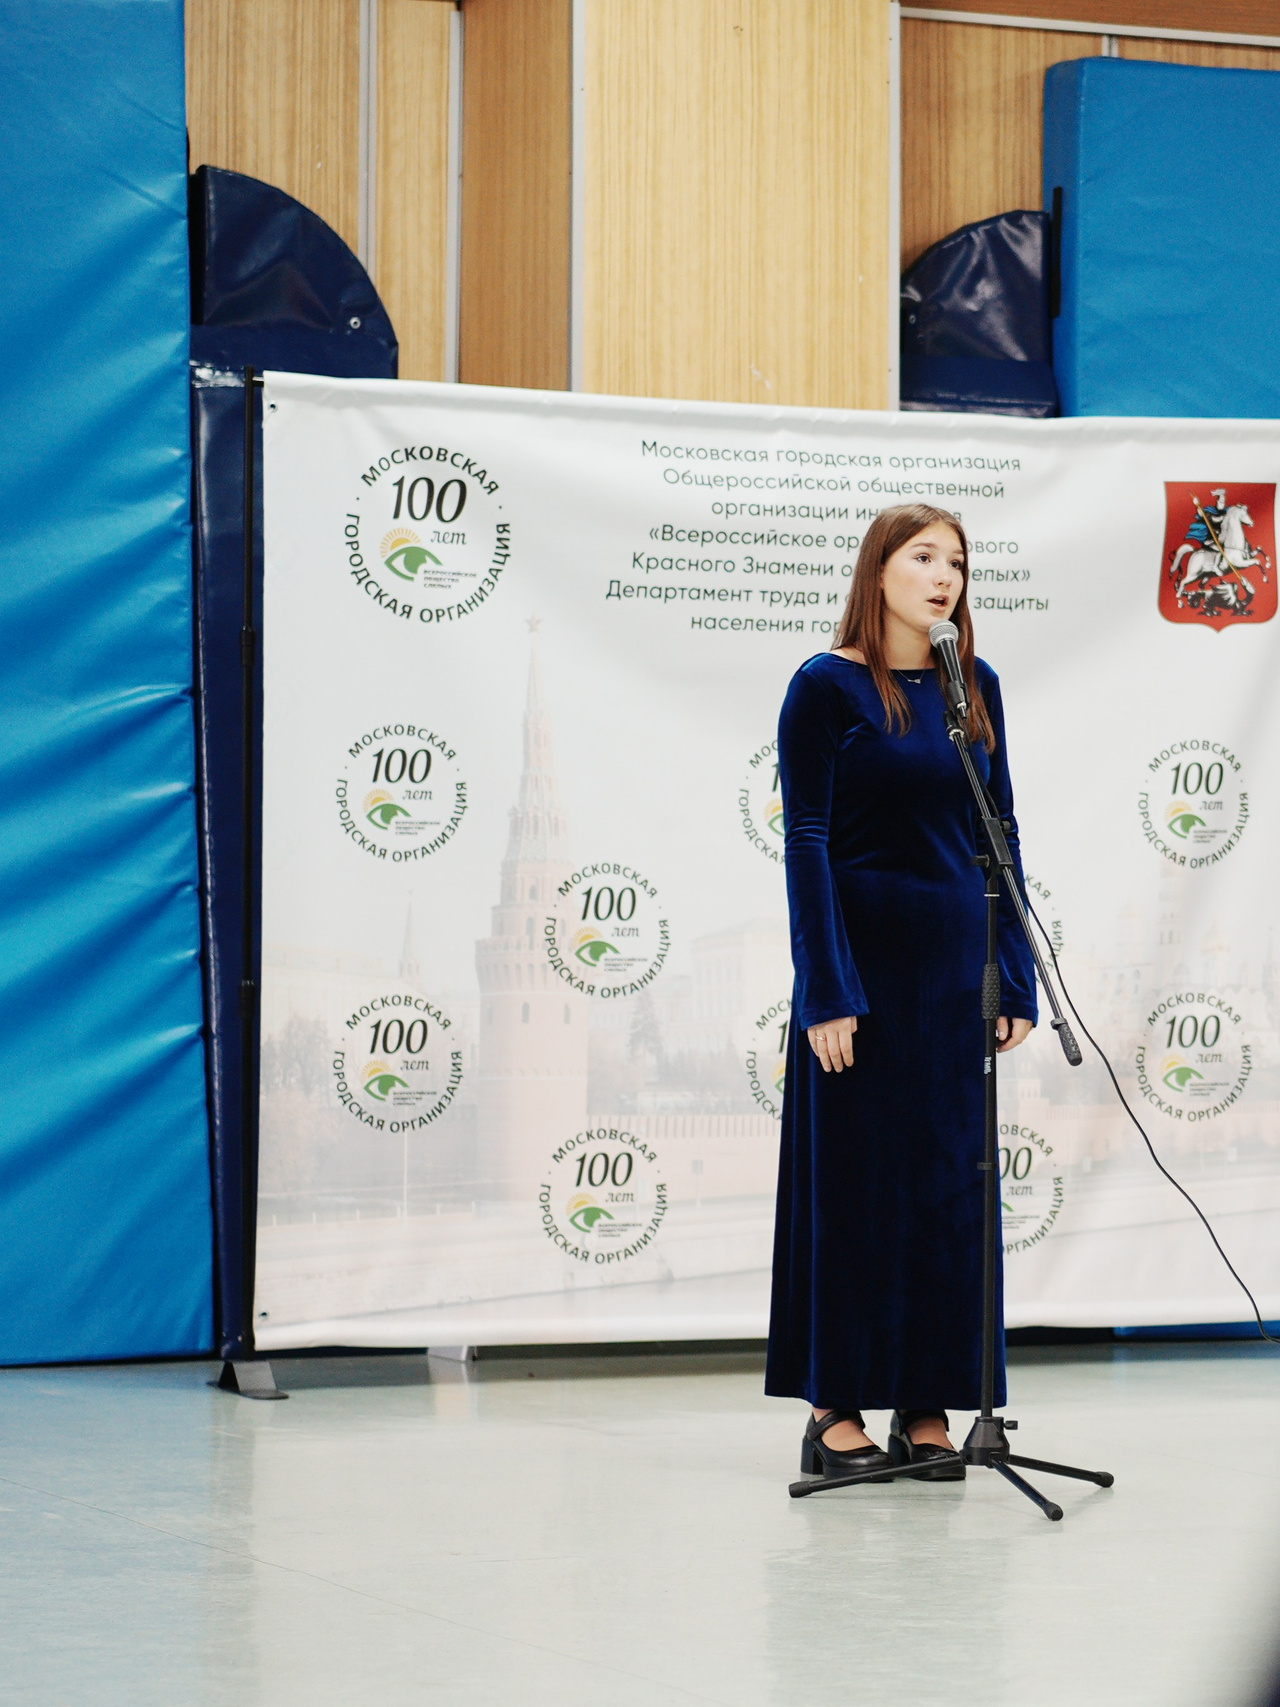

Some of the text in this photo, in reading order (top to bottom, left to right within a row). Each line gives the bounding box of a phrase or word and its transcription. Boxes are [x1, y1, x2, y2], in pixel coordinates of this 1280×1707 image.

[361, 445, 500, 496] МОСКОВСКАЯ
[641, 440, 1021, 472] Московская городская организация
[392, 475, 467, 523] 100
[663, 468, 1005, 498] Общероссийской общественной
[711, 502, 849, 521] организации
[430, 530, 468, 545] лет
[649, 524, 827, 547] «Всероссийское
[344, 513, 511, 623] ГОРОДСКАЯ ОРГАНИЗАЦИЯ
[632, 551, 736, 574] Красного
[742, 556, 834, 576] Знамени
[971, 568, 1031, 583] епых»
[606, 579, 753, 603] Департамент
[759, 589, 820, 608] труда
[827, 592, 838, 605] и
[973, 596, 1049, 612] защиты
[691, 616, 804, 632] населения
[348, 724, 457, 761] МОСКОВСКАЯ
[1148, 739, 1242, 773] МОСКОВСКАЯ
[372, 748, 432, 784] 100
[1170, 762, 1224, 795] 100
[402, 790, 433, 801] лет
[1200, 800, 1223, 811] лет
[335, 779, 468, 862] ГОРОДСКАЯ ОРГАНИЗАЦИЯ
[1138, 792, 1250, 869] ГОРОДСКАЯ ОРГАНИЗАЦИЯ
[557, 862, 658, 899] МОСКОВСКАЯ
[581, 886, 636, 921] 100
[611, 927, 640, 938] лет
[544, 917, 671, 999] ГОРОДСКАЯ ОРГАНИЗАЦИЯ
[345, 995, 452, 1030] МОСКОВСКАЯ
[1147, 992, 1242, 1026] МОСКОВСКАЯ
[370, 1019, 428, 1054] 100
[1166, 1014, 1221, 1049] 100
[400, 1060, 430, 1071] лет
[1195, 1053, 1223, 1064] лет
[332, 1050, 464, 1133] ГОРОДСКАЯ ОРГАНИЗАЦИЯ
[746, 1050, 783, 1120] ГОРОДСК
[1135, 1044, 1253, 1122] ГОРОДСКАЯ ОРГАНИЗАЦИЯ
[551, 1128, 657, 1164] МОСКОВСКАЯ
[999, 1123, 1054, 1157] ОВСКАЯ
[575, 1152, 634, 1187] 100
[998, 1147, 1032, 1181] 00
[605, 1192, 635, 1203] лет
[1006, 1185, 1033, 1196] лет
[539, 1183, 669, 1264] ГОРОДСКАЯ ОРГАНИЗАЦИЯ
[1002, 1176, 1064, 1255] РГАНИЗАЦИЯ
